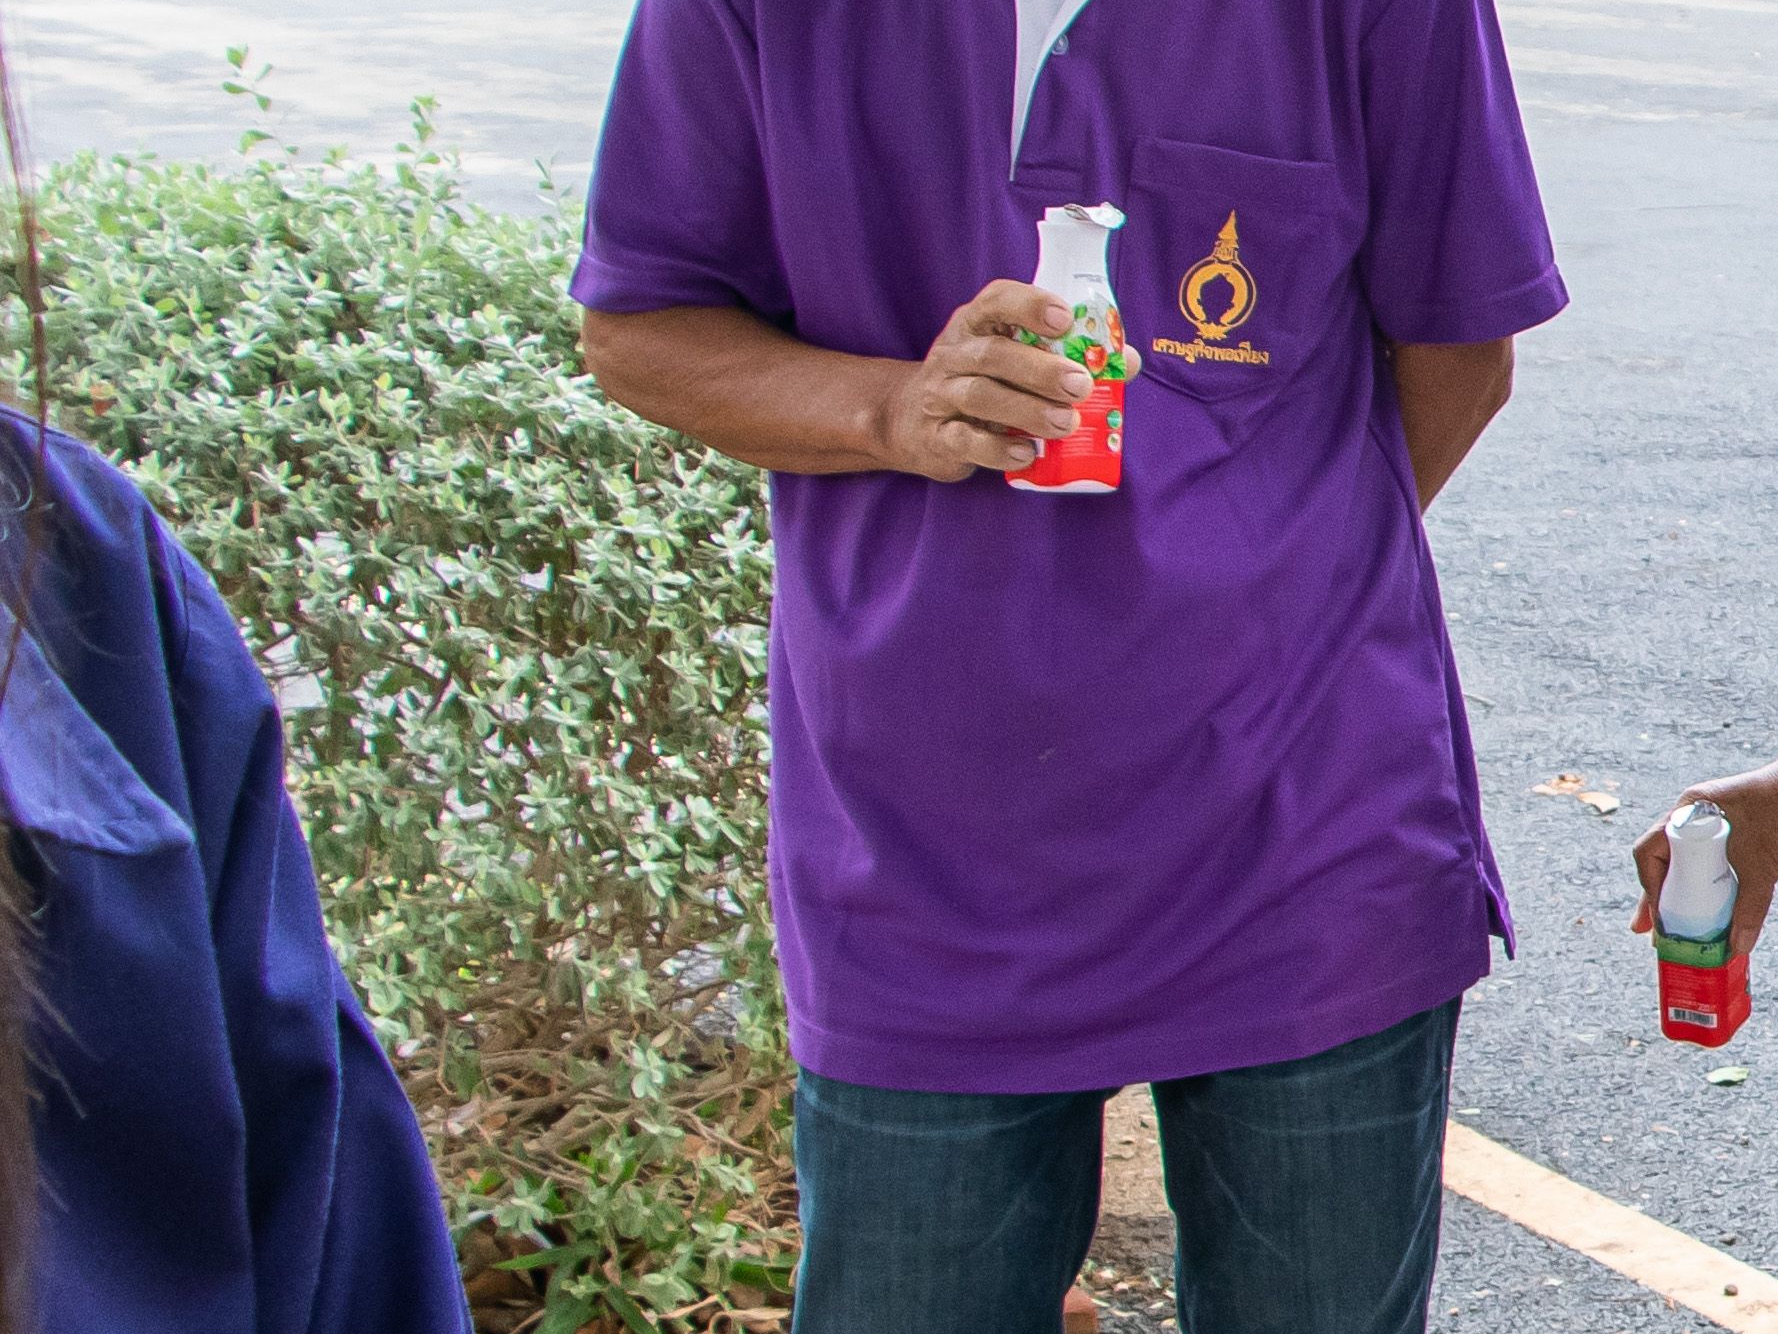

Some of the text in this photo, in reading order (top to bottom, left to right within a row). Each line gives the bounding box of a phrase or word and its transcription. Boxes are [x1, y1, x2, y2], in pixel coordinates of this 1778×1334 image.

[1152, 337, 1270, 365] เศรษฐกิจพอเพียง
